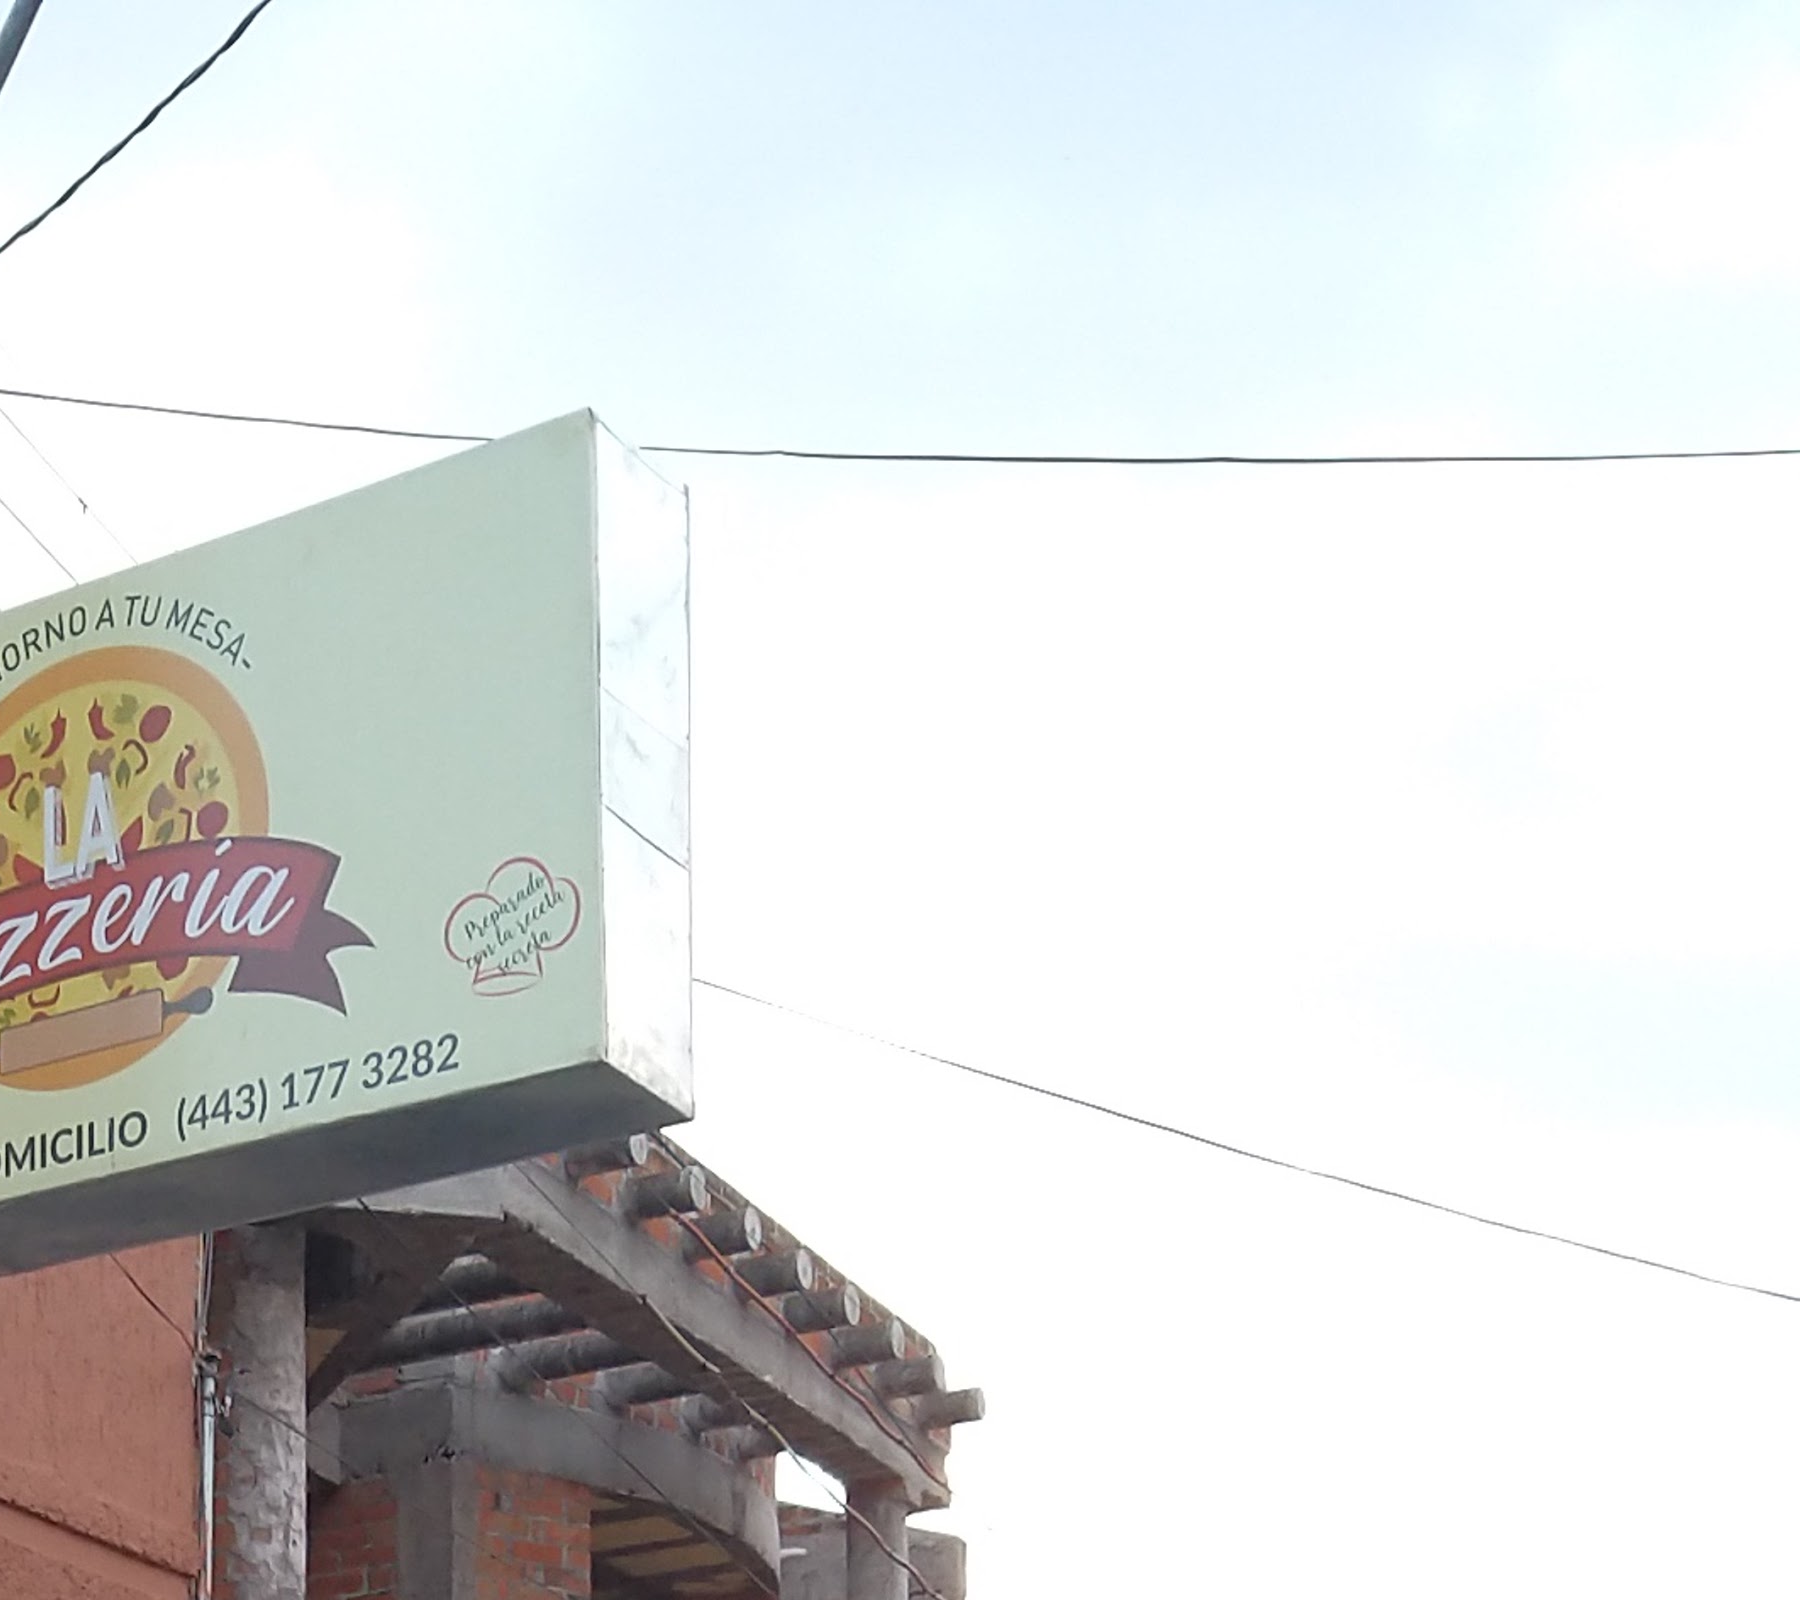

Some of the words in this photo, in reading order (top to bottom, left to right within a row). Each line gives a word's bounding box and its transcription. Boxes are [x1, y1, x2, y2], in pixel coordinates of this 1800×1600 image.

[94, 599, 115, 631] A
[124, 595, 162, 628] TU
[44, 771, 125, 889] LA
[464, 872, 545, 941] Preparado
[466, 942, 497, 971] con
[495, 920, 516, 946] la
[515, 890, 566, 934] receta
[497, 929, 551, 976] secreta
[177, 1077, 268, 1142] (443)
[281, 1058, 350, 1111] 177
[361, 1033, 460, 1090] 3282
